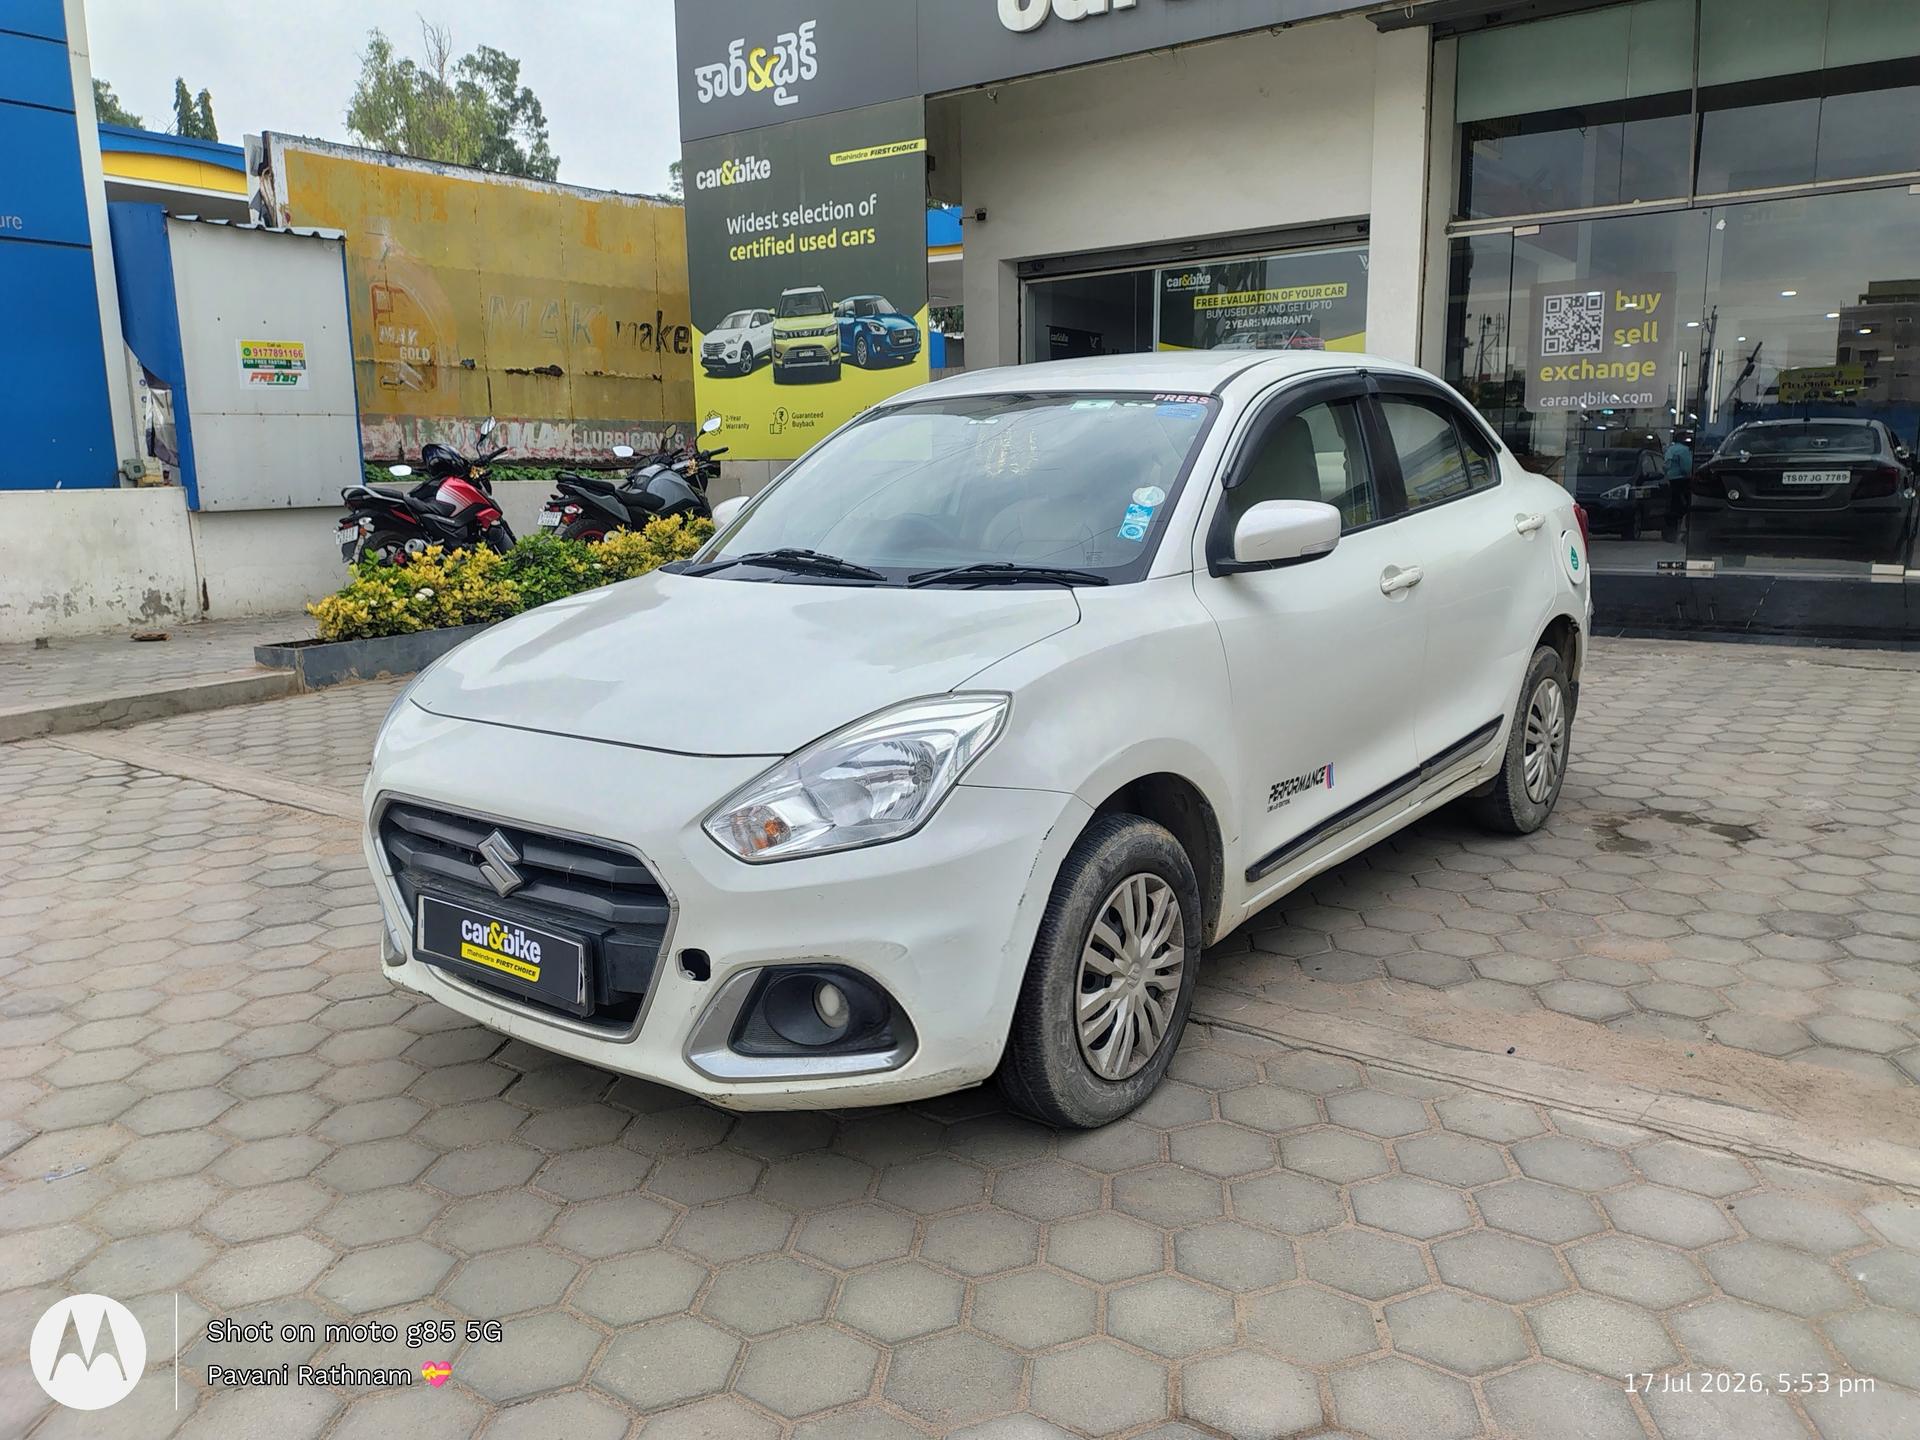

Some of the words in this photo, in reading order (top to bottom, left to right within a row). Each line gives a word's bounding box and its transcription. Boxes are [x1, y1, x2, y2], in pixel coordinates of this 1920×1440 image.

[695, 20, 817, 106] కార్&బైక్
[836, 151, 868, 162] Mahindra
[870, 147, 891, 156] FIRST
[891, 142, 918, 152] CHOICE
[696, 155, 771, 190] car&bike
[726, 210, 778, 235] Widest
[782, 201, 854, 227] selection
[858, 193, 877, 216] of
[729, 232, 795, 261] certified
[799, 227, 837, 250] used
[841, 228, 876, 247] cars
[1166, 273, 1211, 288] car&bike
[1196, 297, 1219, 307] FREE
[1221, 293, 1279, 306] EVALUATION
[1281, 291, 1294, 300] OF
[1295, 288, 1322, 299] YOUR
[1324, 286, 1345, 296] CAR
[1615, 290, 1661, 314] buy
[1206, 310, 1224, 319] BUY
[1224, 307, 1247, 318] USED
[1248, 305, 1268, 316] CAR
[1268, 303, 1286, 314] AND
[1287, 302, 1306, 312] GET
[1306, 301, 1321, 311] UP
[1320, 300, 1333, 309] TO
[613, 309, 691, 354] make
[1225, 321, 1231, 329] 2
[1231, 318, 1260, 329] YEARS
[1261, 314, 1313, 327] WARRANTY
[1614, 320, 1658, 345] sell
[400, 347, 430, 362] GOLD
[1540, 358, 1657, 382] exchange
[1152, 393, 1210, 404] PRESS
[1540, 391, 1653, 407] carandbike.com
[725, 422, 750, 430] Warranty
[791, 411, 824, 420] Guaranteed
[791, 419, 815, 428] Buyback
[1268, 765, 1327, 804] PERFORMANCE
[461, 919, 541, 964] car&bike
[466, 948, 495, 963] Mahindra
[495, 959, 514, 969] FIRST
[514, 964, 536, 977] CHOICE
